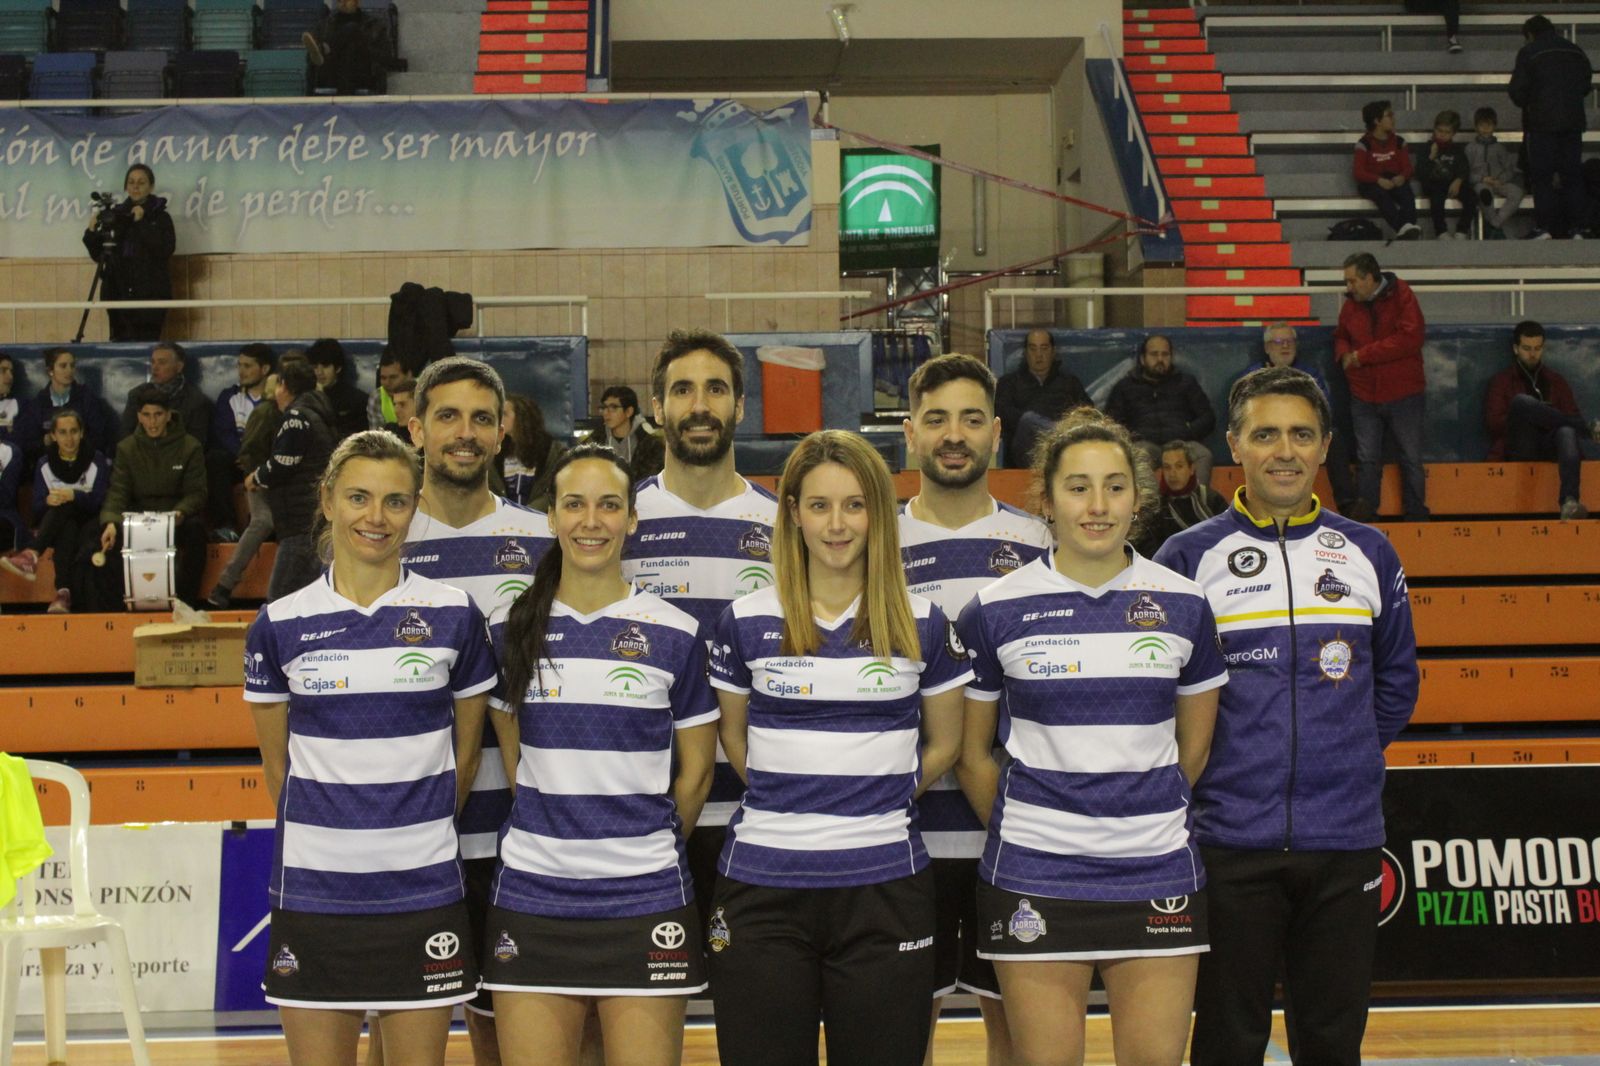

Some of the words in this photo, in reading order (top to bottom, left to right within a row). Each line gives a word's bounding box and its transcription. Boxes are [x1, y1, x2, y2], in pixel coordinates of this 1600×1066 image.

[70, 132, 114, 180] de
[128, 133, 269, 168] ganar
[278, 115, 369, 174] debe
[381, 130, 439, 162] ser
[450, 128, 598, 184] mayor
[184, 176, 228, 230] de
[240, 175, 414, 248] perder...
[641, 531, 686, 542] CEJUDO
[399, 555, 439, 564] EJUDO
[495, 553, 531, 566] LAORDEN
[1314, 550, 1348, 561] TOYOTA
[640, 559, 690, 569] Fundación
[902, 556, 936, 569] EJUDO
[643, 582, 690, 597] Cajasol
[1226, 583, 1272, 597] CEJUDO
[1315, 582, 1351, 597] LAORDEN
[1022, 608, 1074, 622] CEJUDO
[1126, 609, 1167, 623] LAORDEN
[395, 626, 431, 638] LAORDEN
[612, 638, 649, 656] LAORDEN
[1025, 637, 1080, 648] Fundación
[301, 653, 349, 663] Fundación
[765, 660, 814, 668] Fundación
[1028, 661, 1081, 677] Cajasol
[303, 676, 349, 693] Cajasol
[766, 678, 813, 696] Cajasol
[525, 687, 562, 701] ajasol
[101, 881, 192, 904] PINZÓN
[1416, 891, 1489, 926] PIZZA
[1494, 889, 1572, 925] PASTA
[1010, 919, 1045, 934] LAORDEN
[1147, 916, 1192, 925] TOYOTA
[1145, 926, 1169, 934] Toyota
[899, 936, 933, 951] CEJUDO
[649, 951, 688, 960] TOYOTA
[111, 957, 190, 980] eporte
[423, 959, 464, 972] TOYOTA
[423, 973, 445, 981] TOYOTA
[445, 970, 464, 979] HUELVA
[650, 972, 686, 980] CEJUDO
[426, 981, 462, 993] CEJUDO
